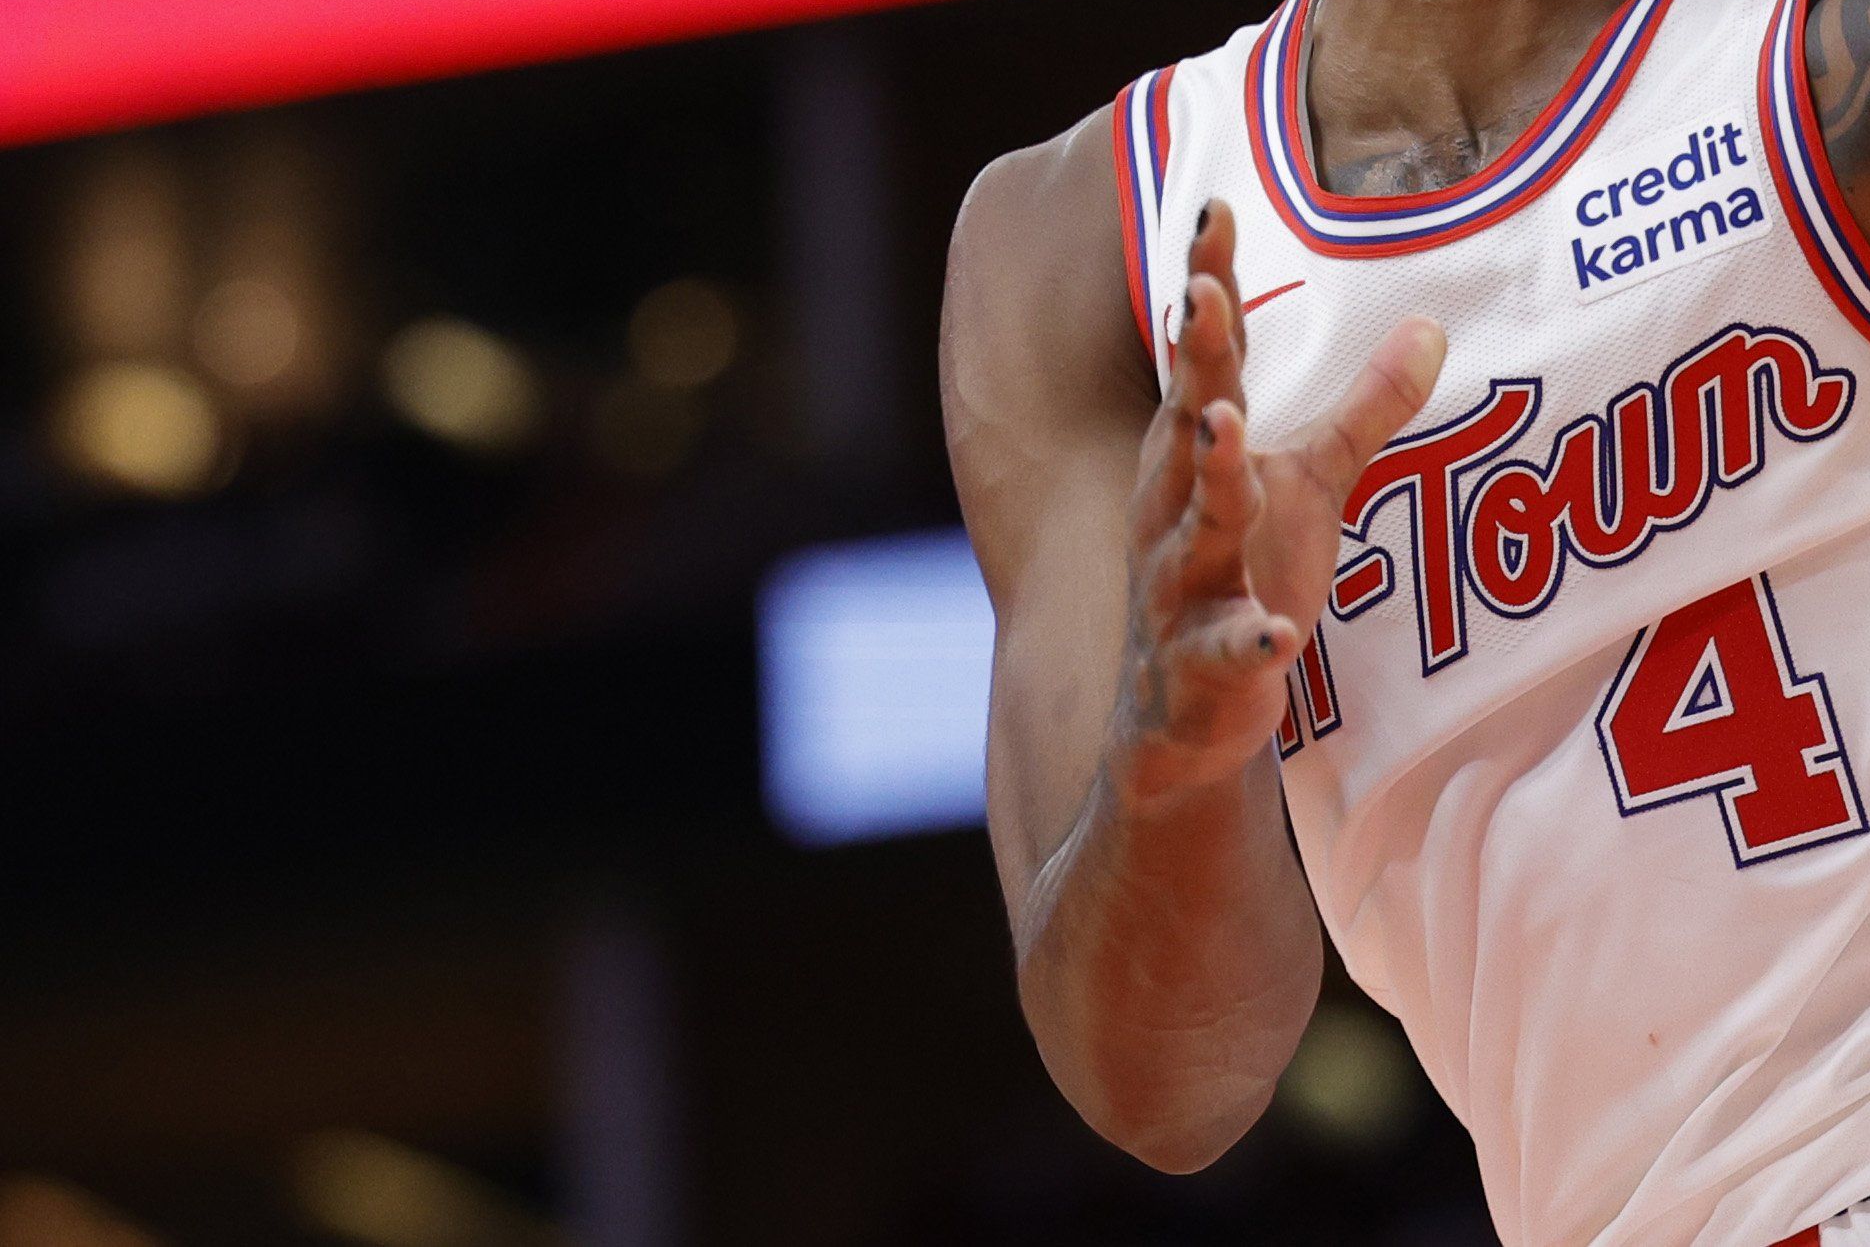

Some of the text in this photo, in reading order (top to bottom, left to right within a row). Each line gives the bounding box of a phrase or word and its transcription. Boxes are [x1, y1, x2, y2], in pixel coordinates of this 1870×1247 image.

[1571, 187, 1765, 291] karma
[1576, 122, 1748, 228] credit
[1276, 321, 1857, 762] -Town
[1595, 570, 1870, 871] 4
